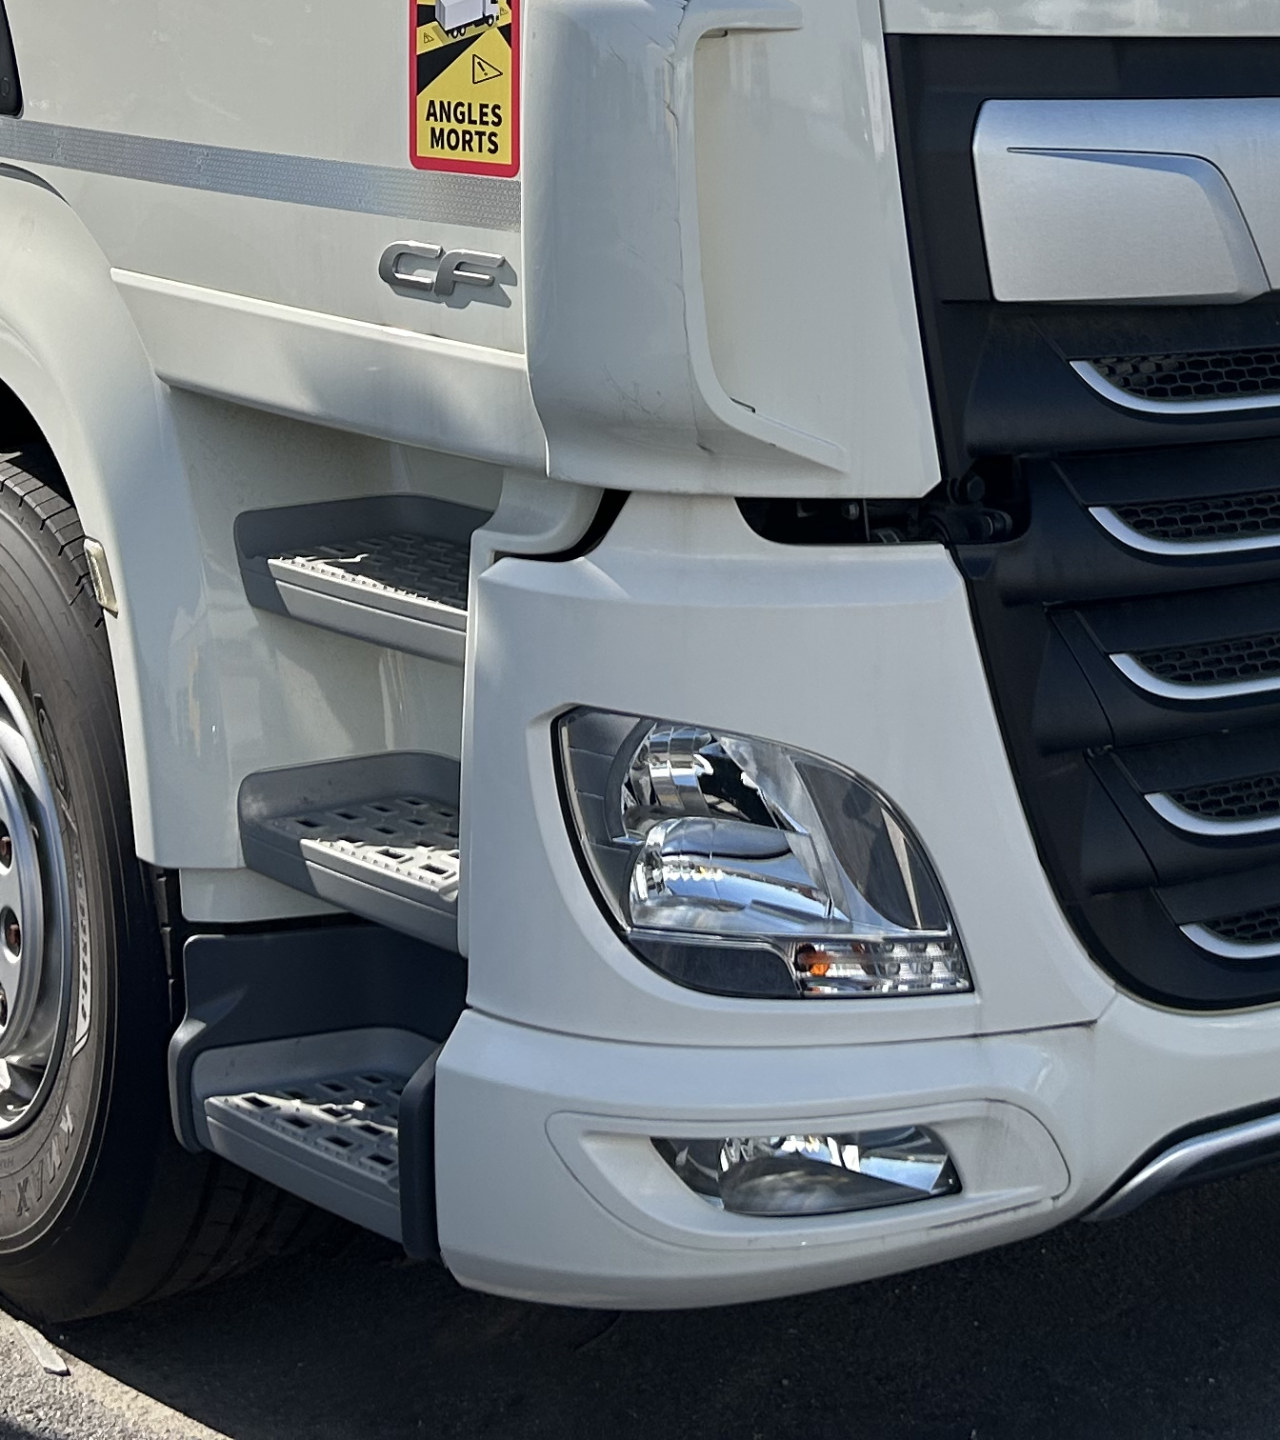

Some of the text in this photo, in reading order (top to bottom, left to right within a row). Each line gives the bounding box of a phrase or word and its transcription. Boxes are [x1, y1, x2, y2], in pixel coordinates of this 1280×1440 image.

[426, 99, 503, 127] ANGLES
[430, 128, 499, 155] MORTS
[378, 240, 506, 297] CF
